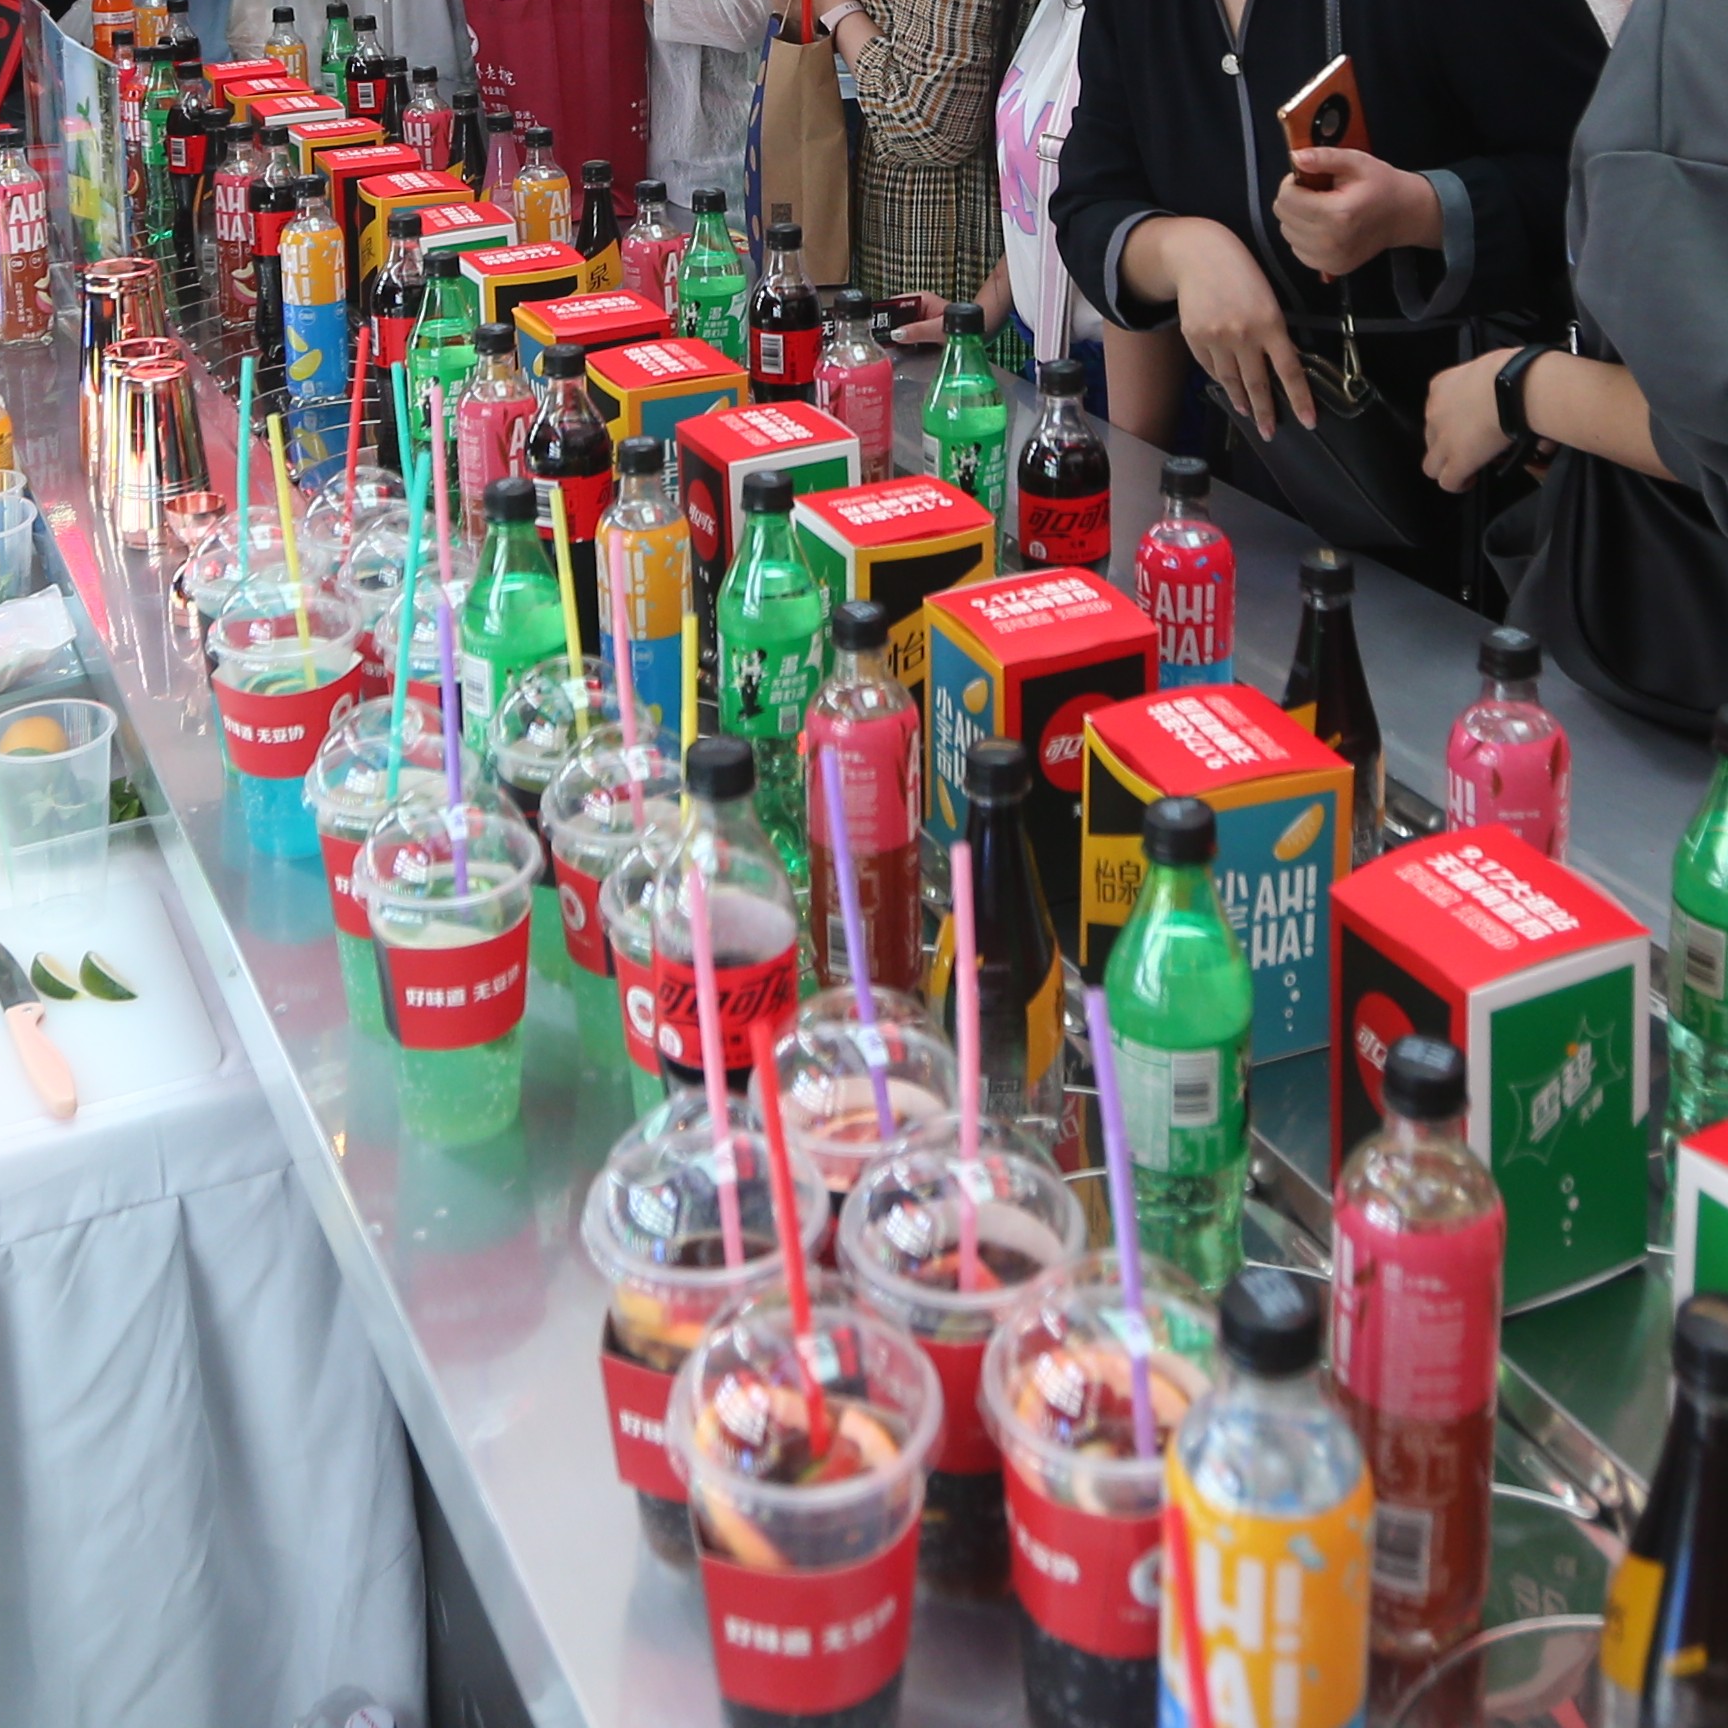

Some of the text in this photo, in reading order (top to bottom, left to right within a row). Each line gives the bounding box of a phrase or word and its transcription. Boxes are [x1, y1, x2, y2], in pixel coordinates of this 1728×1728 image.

[969, 576, 1088, 611] 9.17大连站
[980, 585, 1101, 622] 无糖调查局
[1154, 581, 1216, 623] AH!
[256, 725, 306, 746] 无妥协
[1254, 863, 1318, 917] AH!
[1424, 851, 1546, 943] 无糖调查局
[1457, 842, 1580, 938] 9.17大连站
[1252, 912, 1316, 970] HA!
[404, 987, 467, 1009] 好味道
[724, 1615, 813, 1657] 好味道
